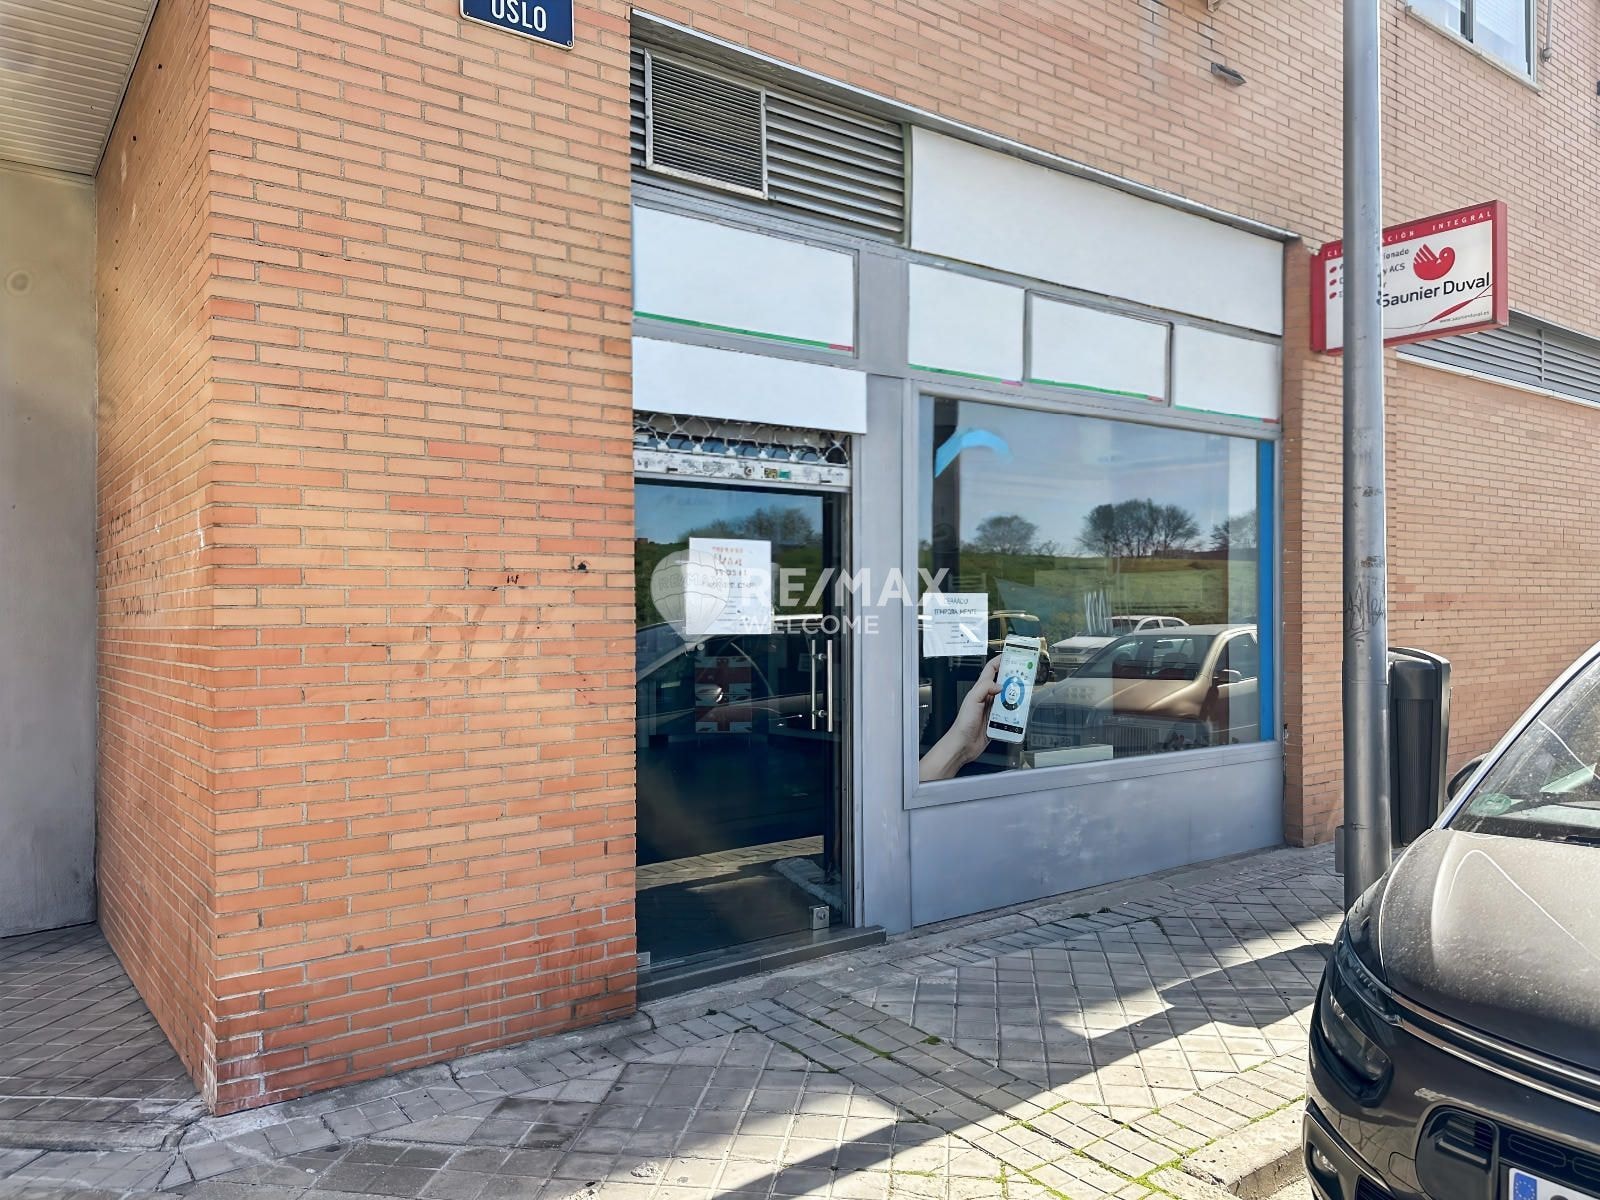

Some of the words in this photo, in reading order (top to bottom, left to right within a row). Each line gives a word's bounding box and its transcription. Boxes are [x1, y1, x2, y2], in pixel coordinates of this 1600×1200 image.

[491, 0, 547, 32] OSLO
[1432, 210, 1492, 231] INTEGRAL
[1383, 248, 1410, 260] ionado
[1389, 262, 1406, 273] ACS
[1378, 284, 1440, 308] Saunier
[1443, 271, 1490, 295] Duval
